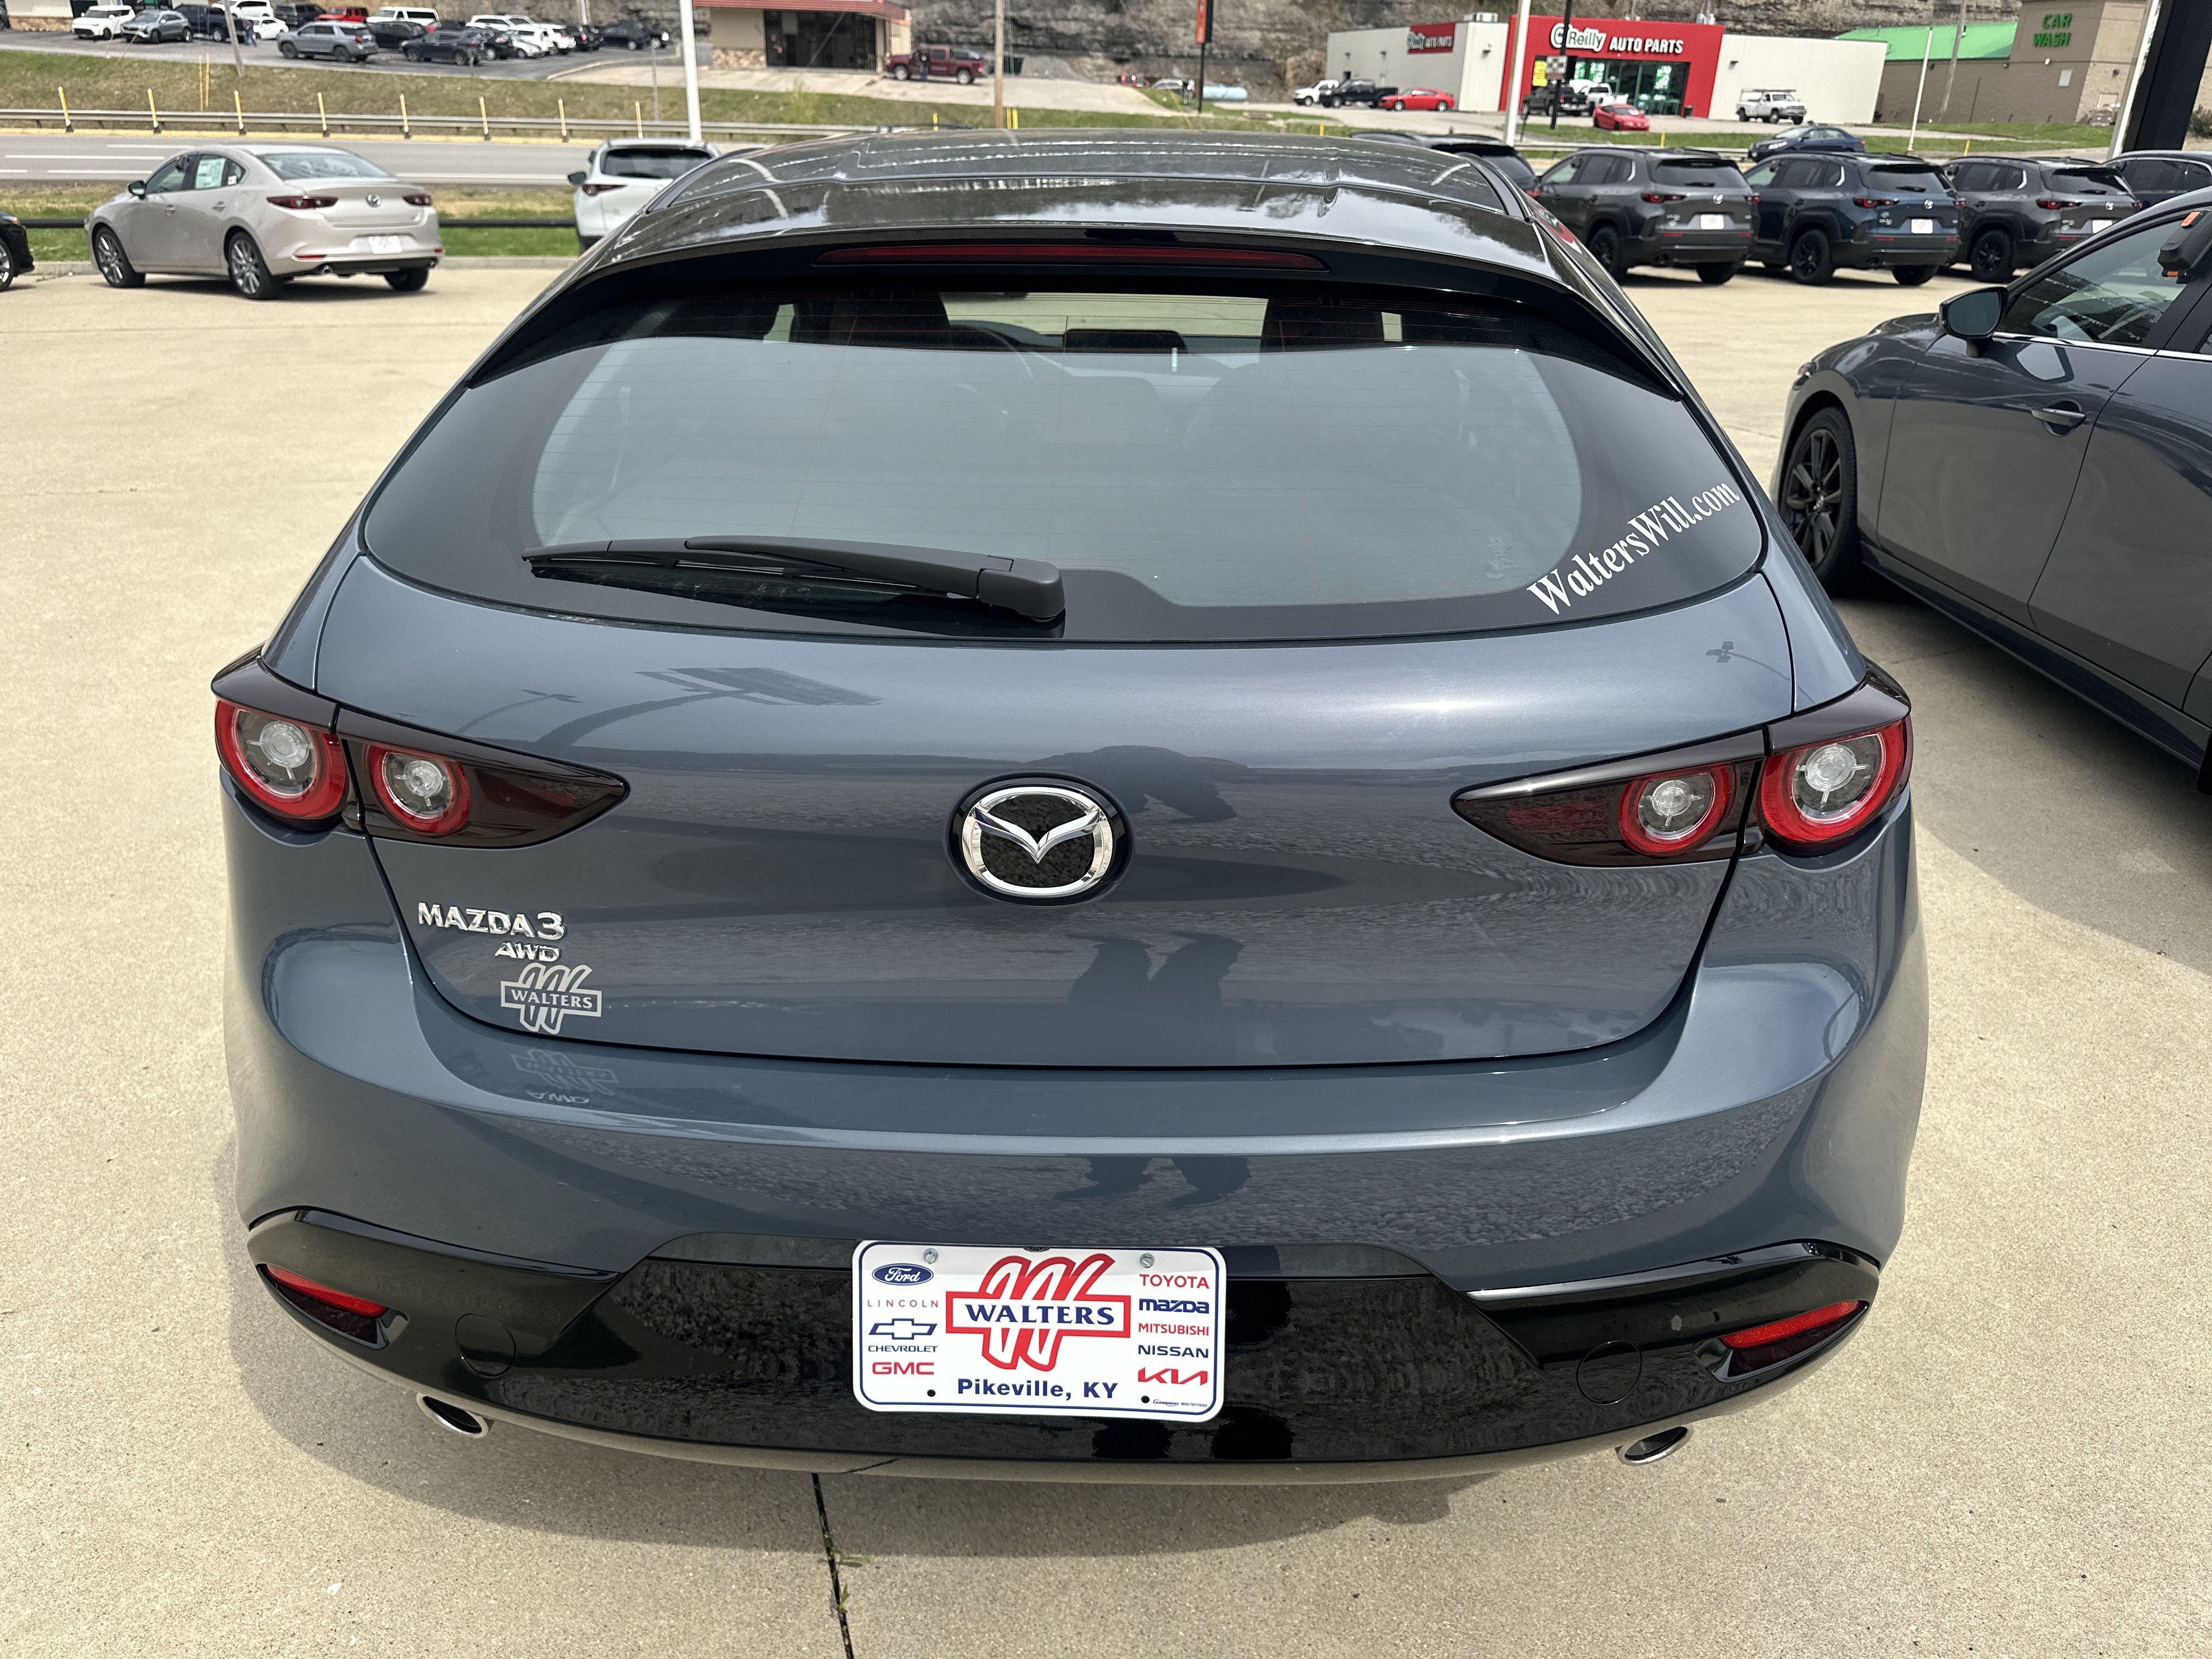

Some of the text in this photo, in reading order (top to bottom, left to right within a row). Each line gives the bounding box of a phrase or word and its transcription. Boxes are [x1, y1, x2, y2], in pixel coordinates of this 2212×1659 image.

[2042, 13, 2072, 30] CAR
[1609, 36, 1644, 52] AUTO
[1644, 38, 1684, 54] PARTS
[2033, 32, 2072, 48] WASH
[1526, 483, 1740, 614] WaltersWill.com
[494, 942, 561, 962] AWD
[511, 989, 593, 1009] WALTERS
[884, 1267, 921, 1283] Ford
[1139, 1273, 1210, 1289] TOYOTA
[867, 1299, 938, 1308] LINCOLN
[964, 1304, 1115, 1325] WALTERS
[1138, 1323, 1209, 1336] MITSUBISHI
[1138, 1344, 1209, 1358] NISSAN
[872, 1362, 934, 1375] GMC
[1138, 1367, 1208, 1386] KIA
[958, 1378, 1119, 1401] Pikeville, KY
